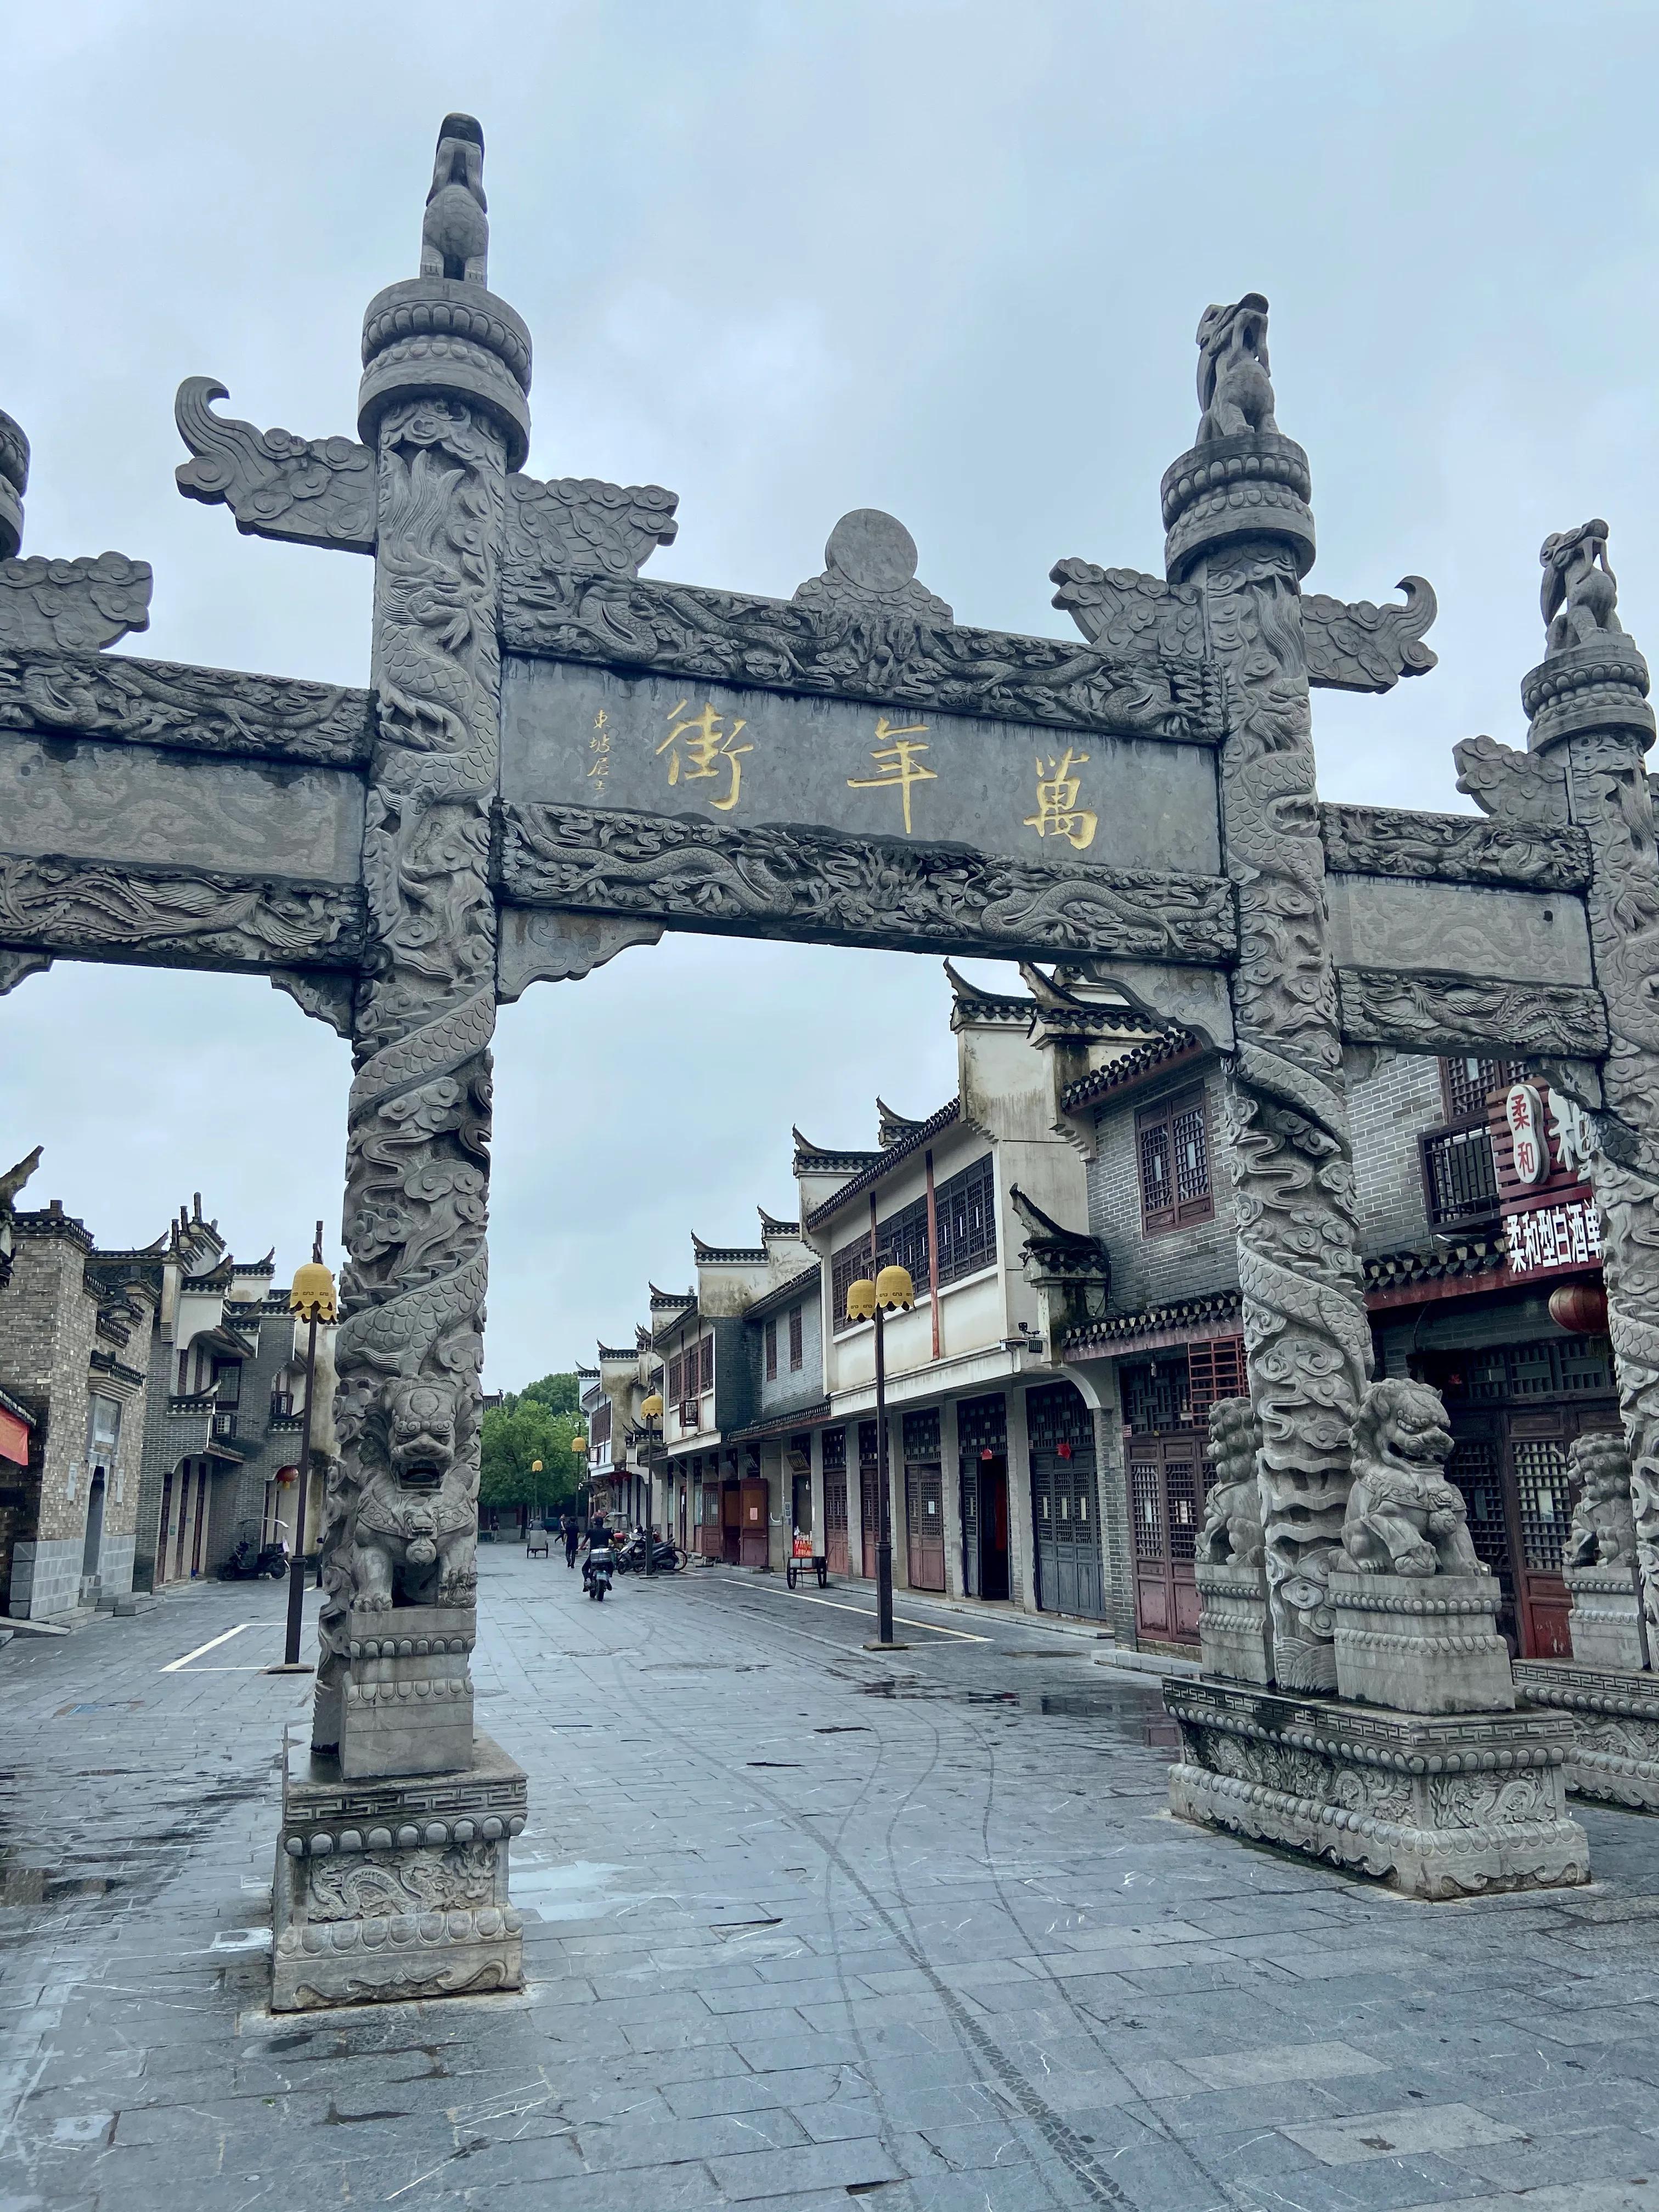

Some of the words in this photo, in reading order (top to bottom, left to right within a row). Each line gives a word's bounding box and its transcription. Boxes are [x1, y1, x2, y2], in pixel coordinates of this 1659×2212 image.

[586, 709, 615, 790] 東坡居士
[1511, 1094, 1535, 1177] 柔和
